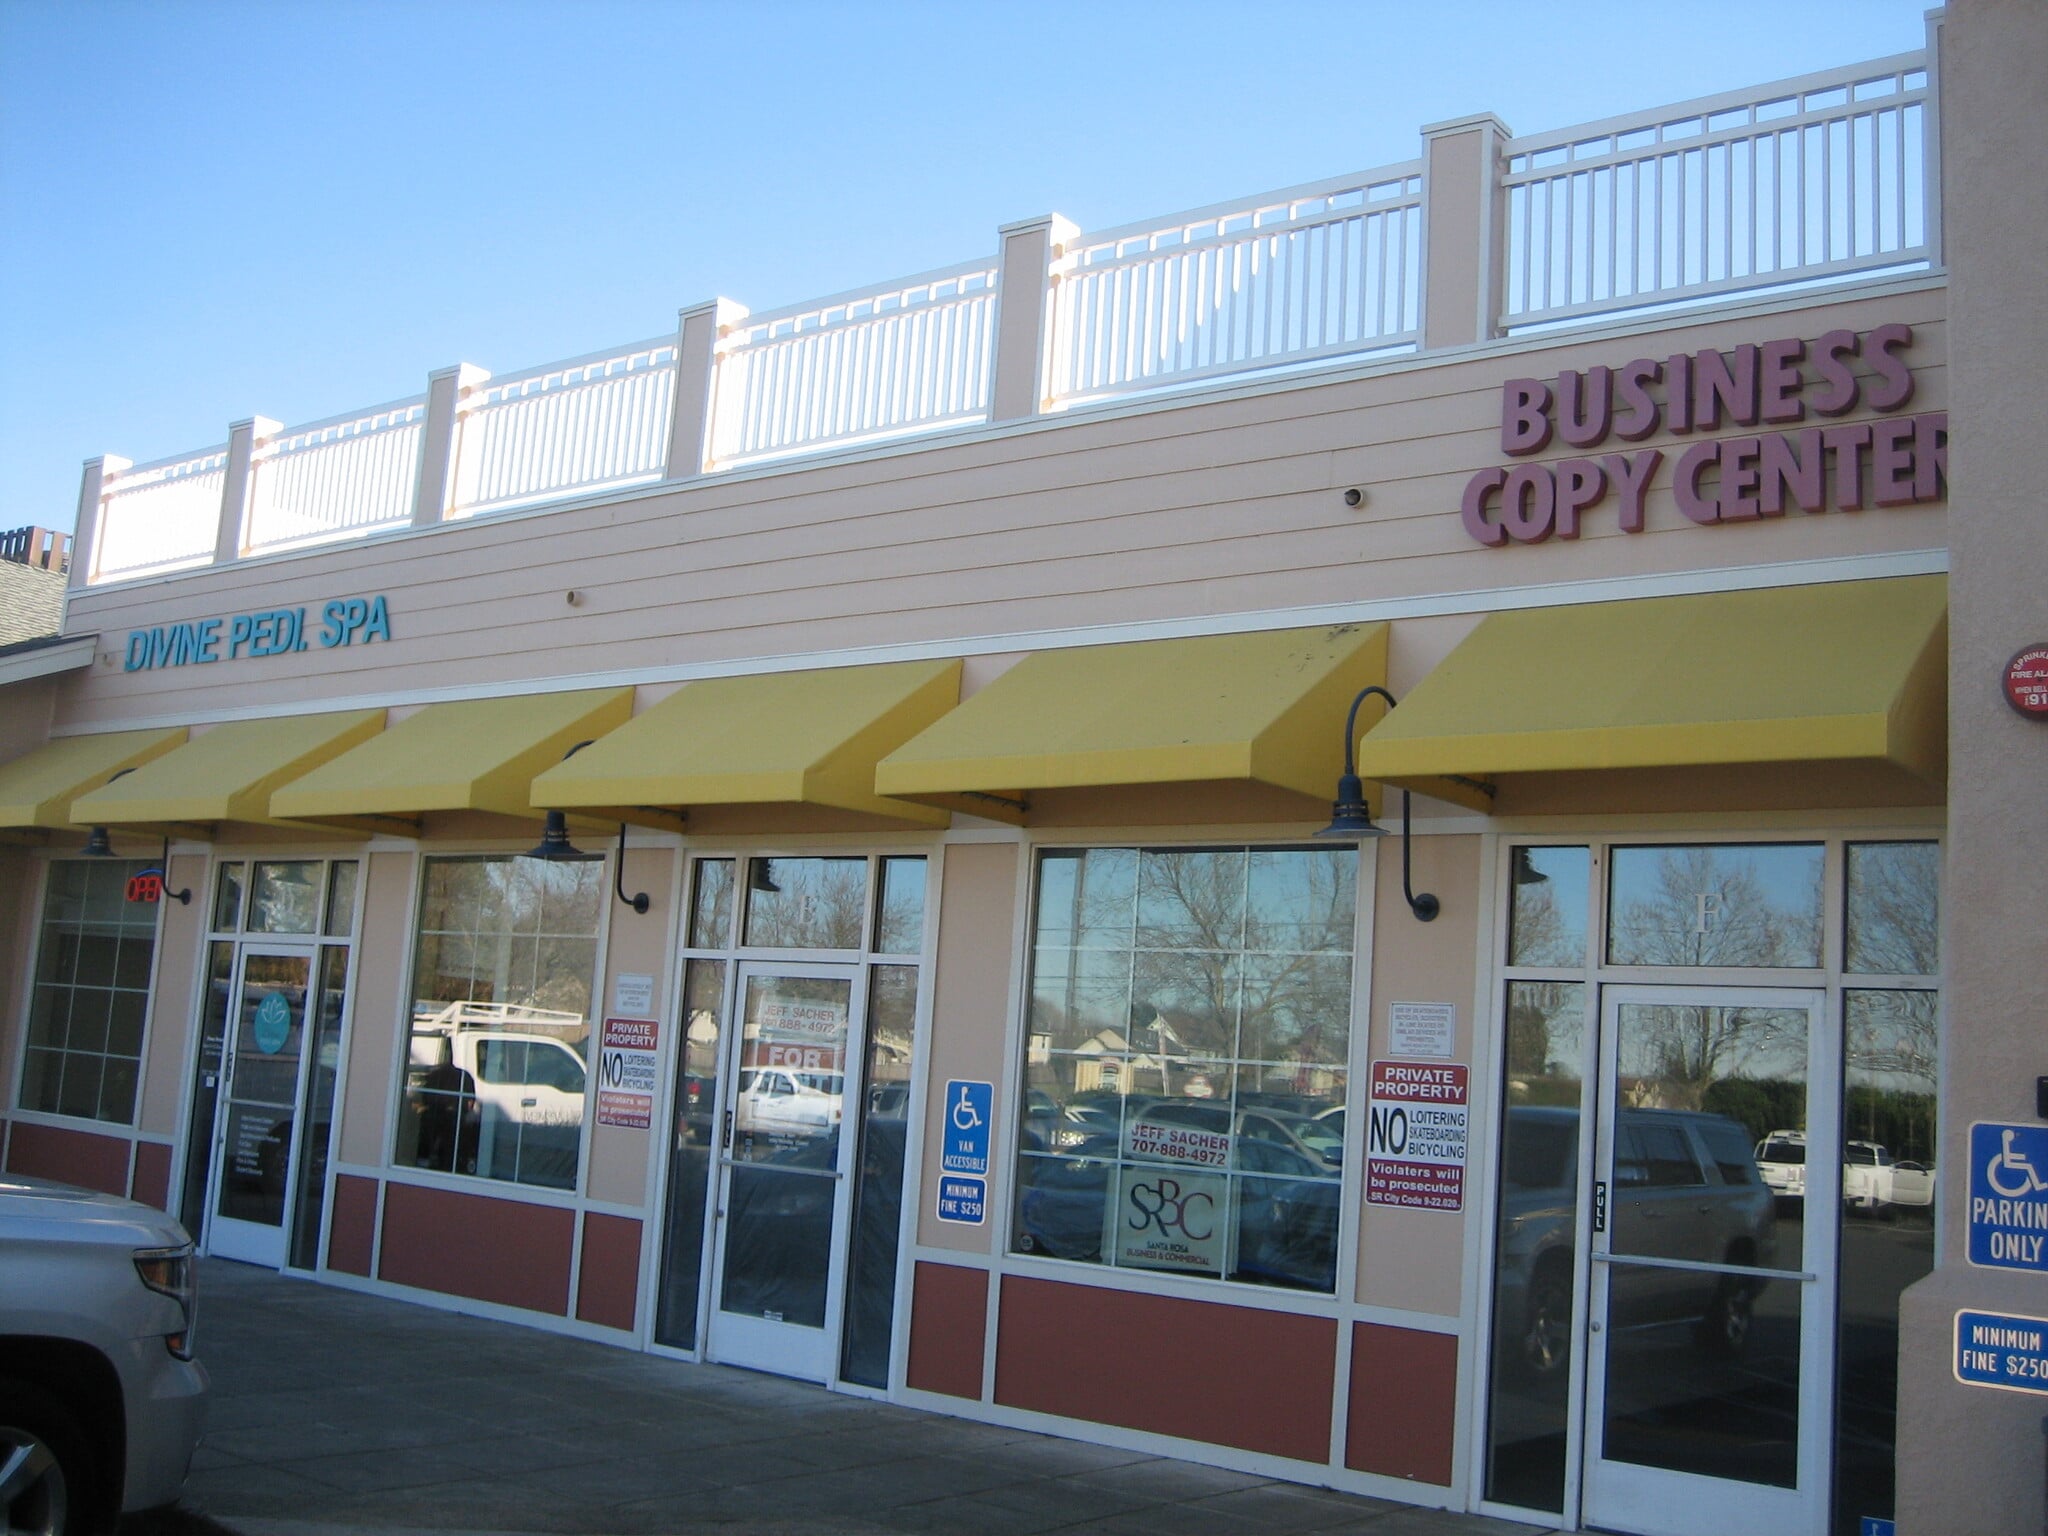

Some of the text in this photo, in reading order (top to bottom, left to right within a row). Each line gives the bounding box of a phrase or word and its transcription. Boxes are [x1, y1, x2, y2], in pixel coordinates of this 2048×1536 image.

[1501, 322, 1916, 457] BUSINESS
[1461, 412, 1948, 548] COPY CENTER
[124, 618, 223, 673] DIVINE
[319, 594, 391, 649] SPA
[2011, 671, 2033, 679] FIRE
[766, 1005, 834, 1021] JEFF SACHER
[611, 1022, 651, 1036] PRIVATE
[605, 1032, 656, 1047] PROPERTY
[624, 1054, 656, 1067] LOITERING
[601, 1052, 623, 1088] NO
[1385, 1067, 1454, 1084] PRIVATE
[622, 1078, 654, 1091] BICYCLING
[1374, 1081, 1464, 1099] PROPERTY
[1410, 1110, 1466, 1127] LOITERING
[1131, 1122, 1230, 1151] JEFF SACHER
[1370, 1106, 1408, 1155] NO
[1409, 1126, 1466, 1143] SKATEBOARDING
[958, 1139, 974, 1153] VAN
[1131, 1138, 1226, 1166] 707-888-4972
[1408, 1142, 1465, 1159] BICYCLING
[944, 1154, 986, 1171] ACCESSIBLE
[1371, 1162, 1460, 1180] Violaters will
[945, 1183, 979, 1199] MINIMUM
[1370, 1176, 1460, 1195] be prosecuted
[940, 1199, 957, 1214] FINE
[1371, 1191, 1383, 1201] SR
[1384, 1192, 1400, 1205] City
[1401, 1194, 1423, 1205] Code
[1596, 1185, 1605, 1228] PULL
[1147, 1241, 1189, 1253] SANTA ROSA
[1990, 1230, 2044, 1263] ONLY
[1126, 1247, 1157, 1260] BUSINESS
[1164, 1253, 1210, 1266] COMMERCIAL
[1972, 1325, 2041, 1352] MINIMUM
[1962, 1350, 2048, 1379] FINE $250
